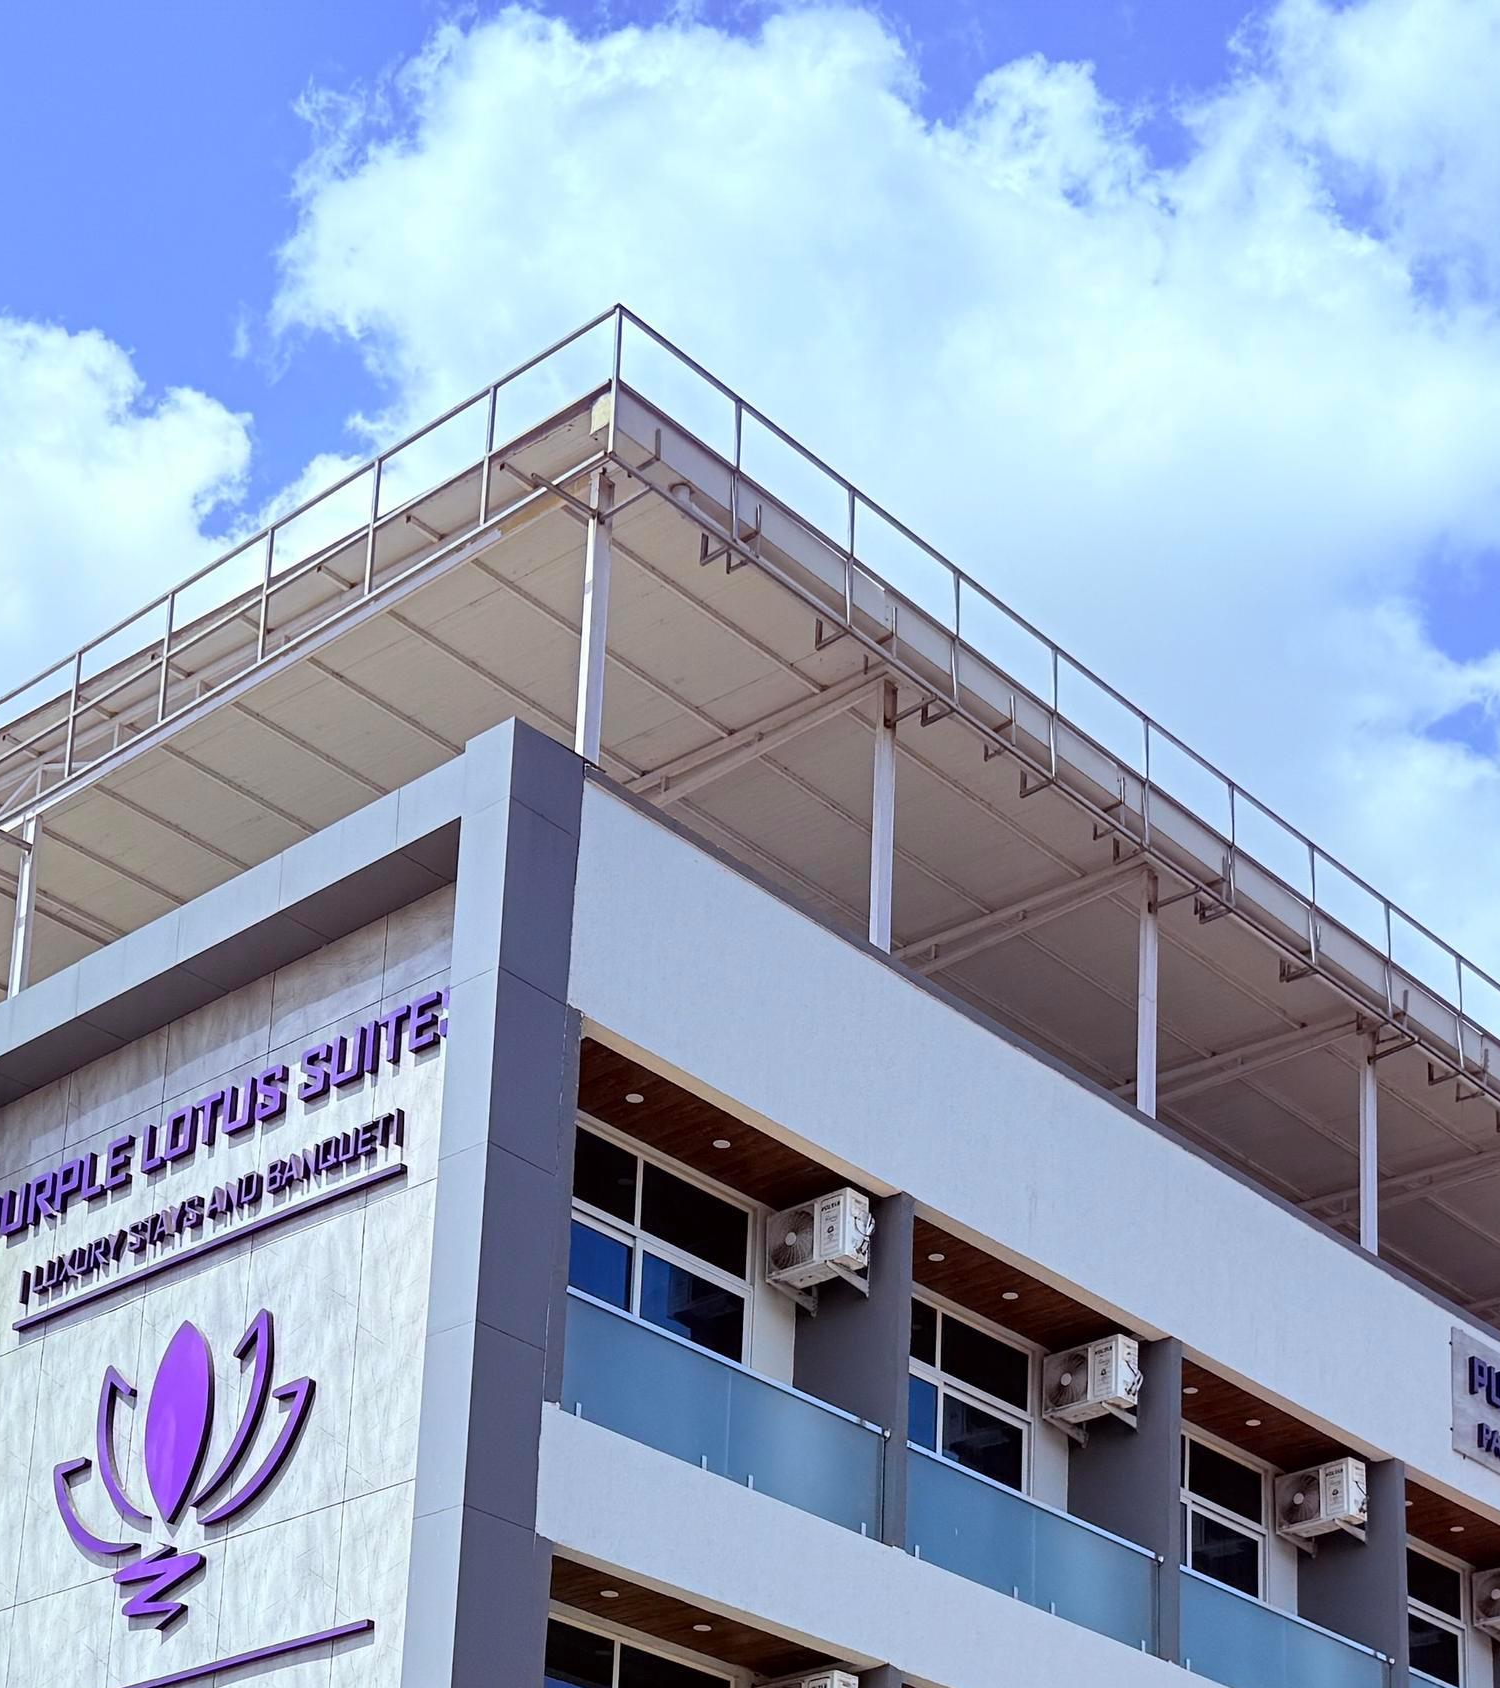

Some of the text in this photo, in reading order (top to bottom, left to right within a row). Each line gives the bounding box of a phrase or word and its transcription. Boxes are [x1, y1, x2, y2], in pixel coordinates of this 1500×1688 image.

[140, 1064, 290, 1175] LOTUS
[32, 1112, 395, 1295] LUXURY STAYS AND BANQUET
